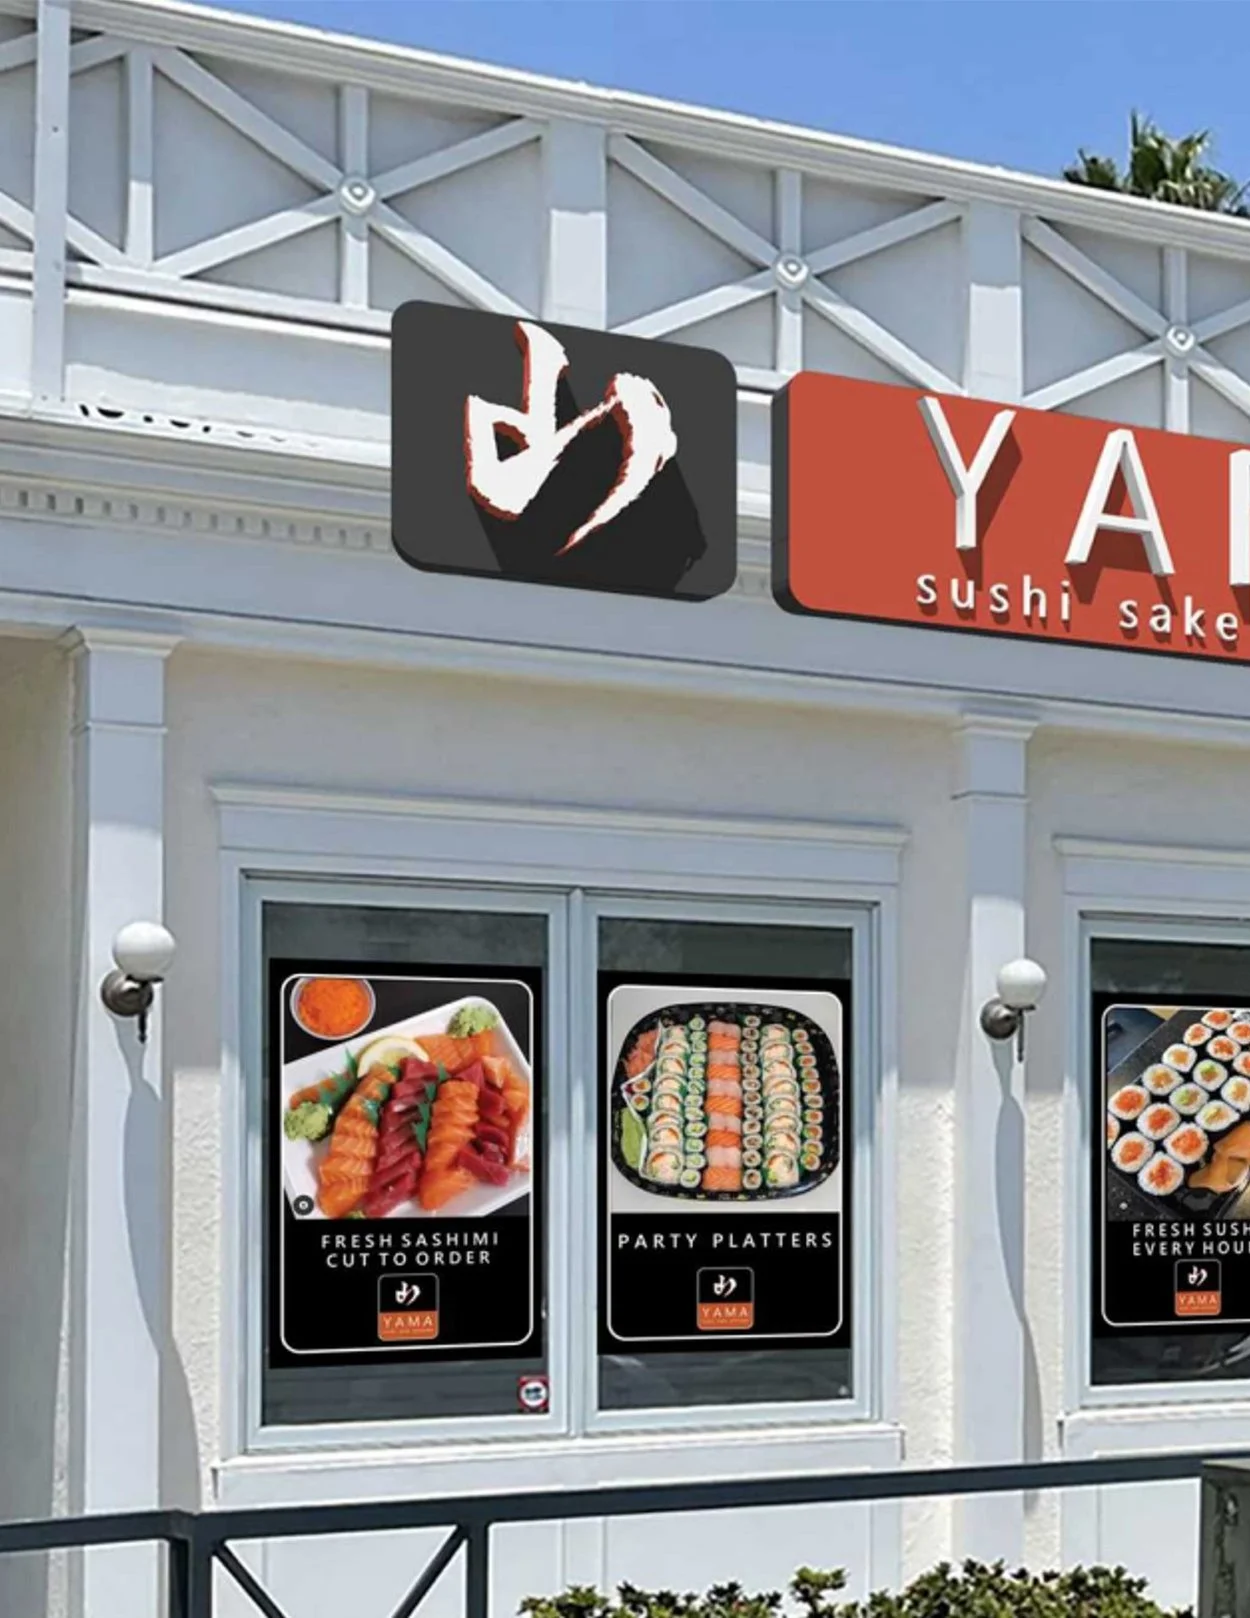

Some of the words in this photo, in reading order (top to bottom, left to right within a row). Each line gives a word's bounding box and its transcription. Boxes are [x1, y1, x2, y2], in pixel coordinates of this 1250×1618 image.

[916, 573, 1070, 620] sushi
[1119, 595, 1238, 641] sake
[1132, 1223, 1195, 1238] FRESH
[321, 1233, 393, 1249] FRESH
[401, 1231, 499, 1247] SASHIMI
[618, 1233, 698, 1249] PARTY
[712, 1232, 833, 1248] PLATTERS
[1132, 1241, 1195, 1256] EVERY
[326, 1253, 371, 1268] CUT
[379, 1252, 407, 1266] TO
[415, 1250, 491, 1266] ORDER
[1178, 1294, 1218, 1305] YAMA
[701, 1306, 749, 1318] YAMA
[382, 1315, 433, 1329] YAMA
